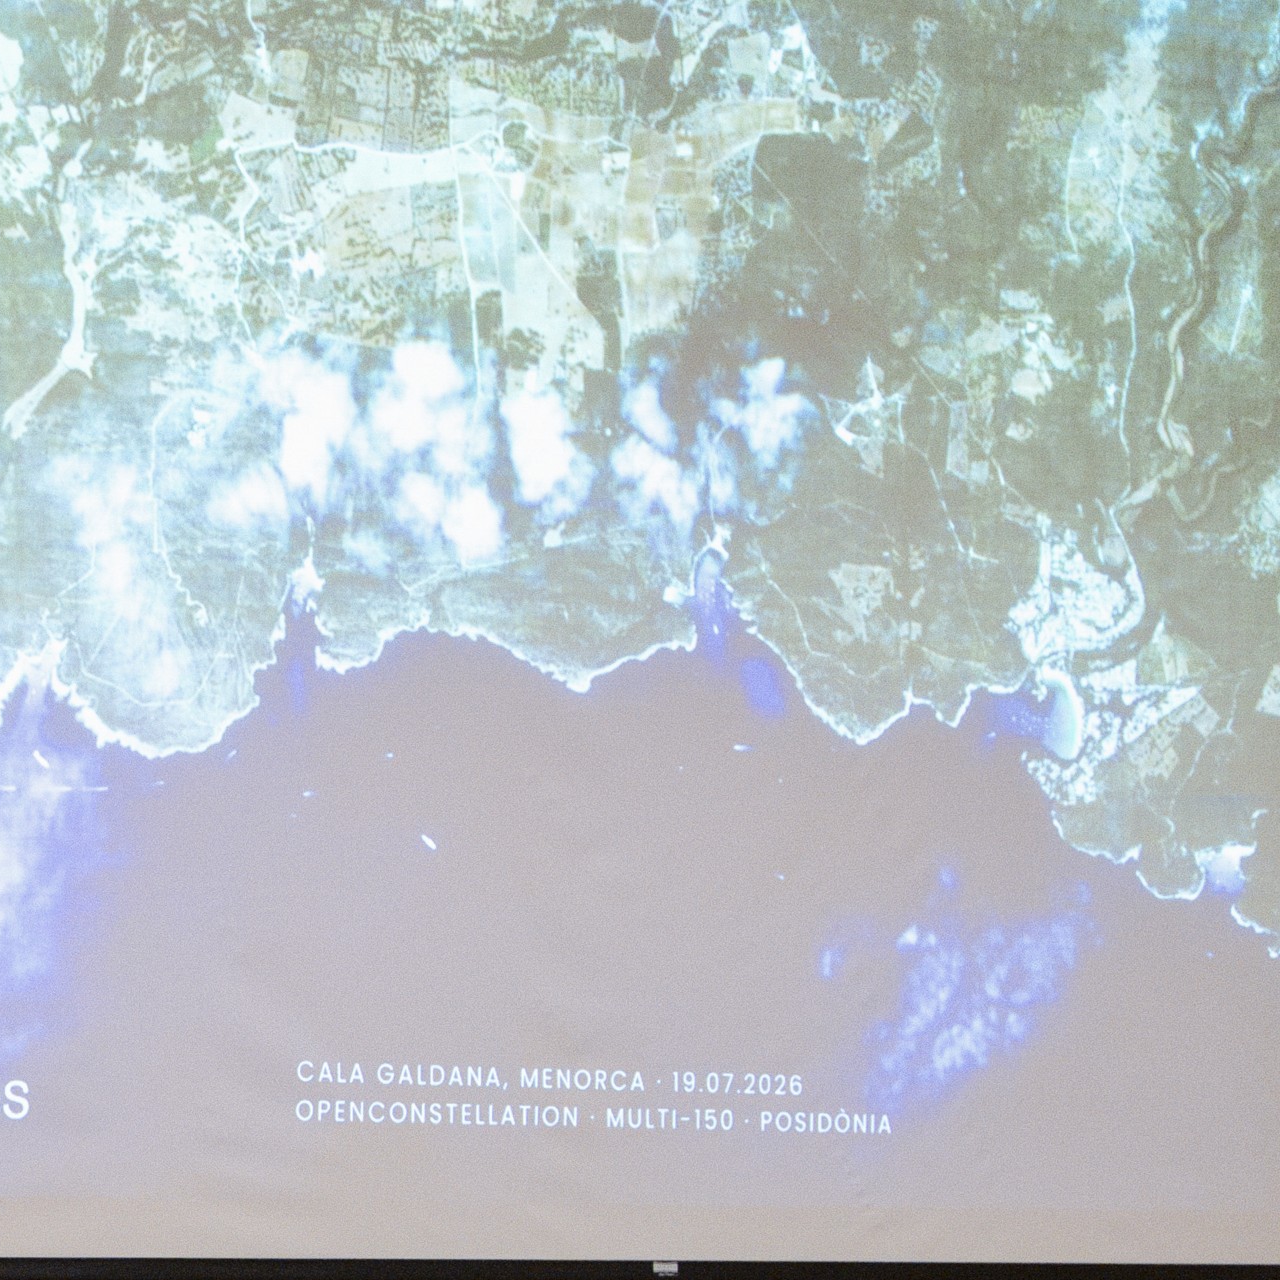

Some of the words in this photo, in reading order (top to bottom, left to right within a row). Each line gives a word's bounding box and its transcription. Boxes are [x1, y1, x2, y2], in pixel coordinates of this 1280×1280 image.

[296, 1060, 364, 1084] CALA
[376, 1062, 508, 1090] GALDANA,
[520, 1067, 645, 1092] MENORCA
[672, 1071, 803, 1096] 19.07.2026
[295, 1099, 579, 1127] OPENCONSTELLATION
[606, 1108, 734, 1131] MULTI-150
[760, 1108, 891, 1134] POSIDÒNIA
